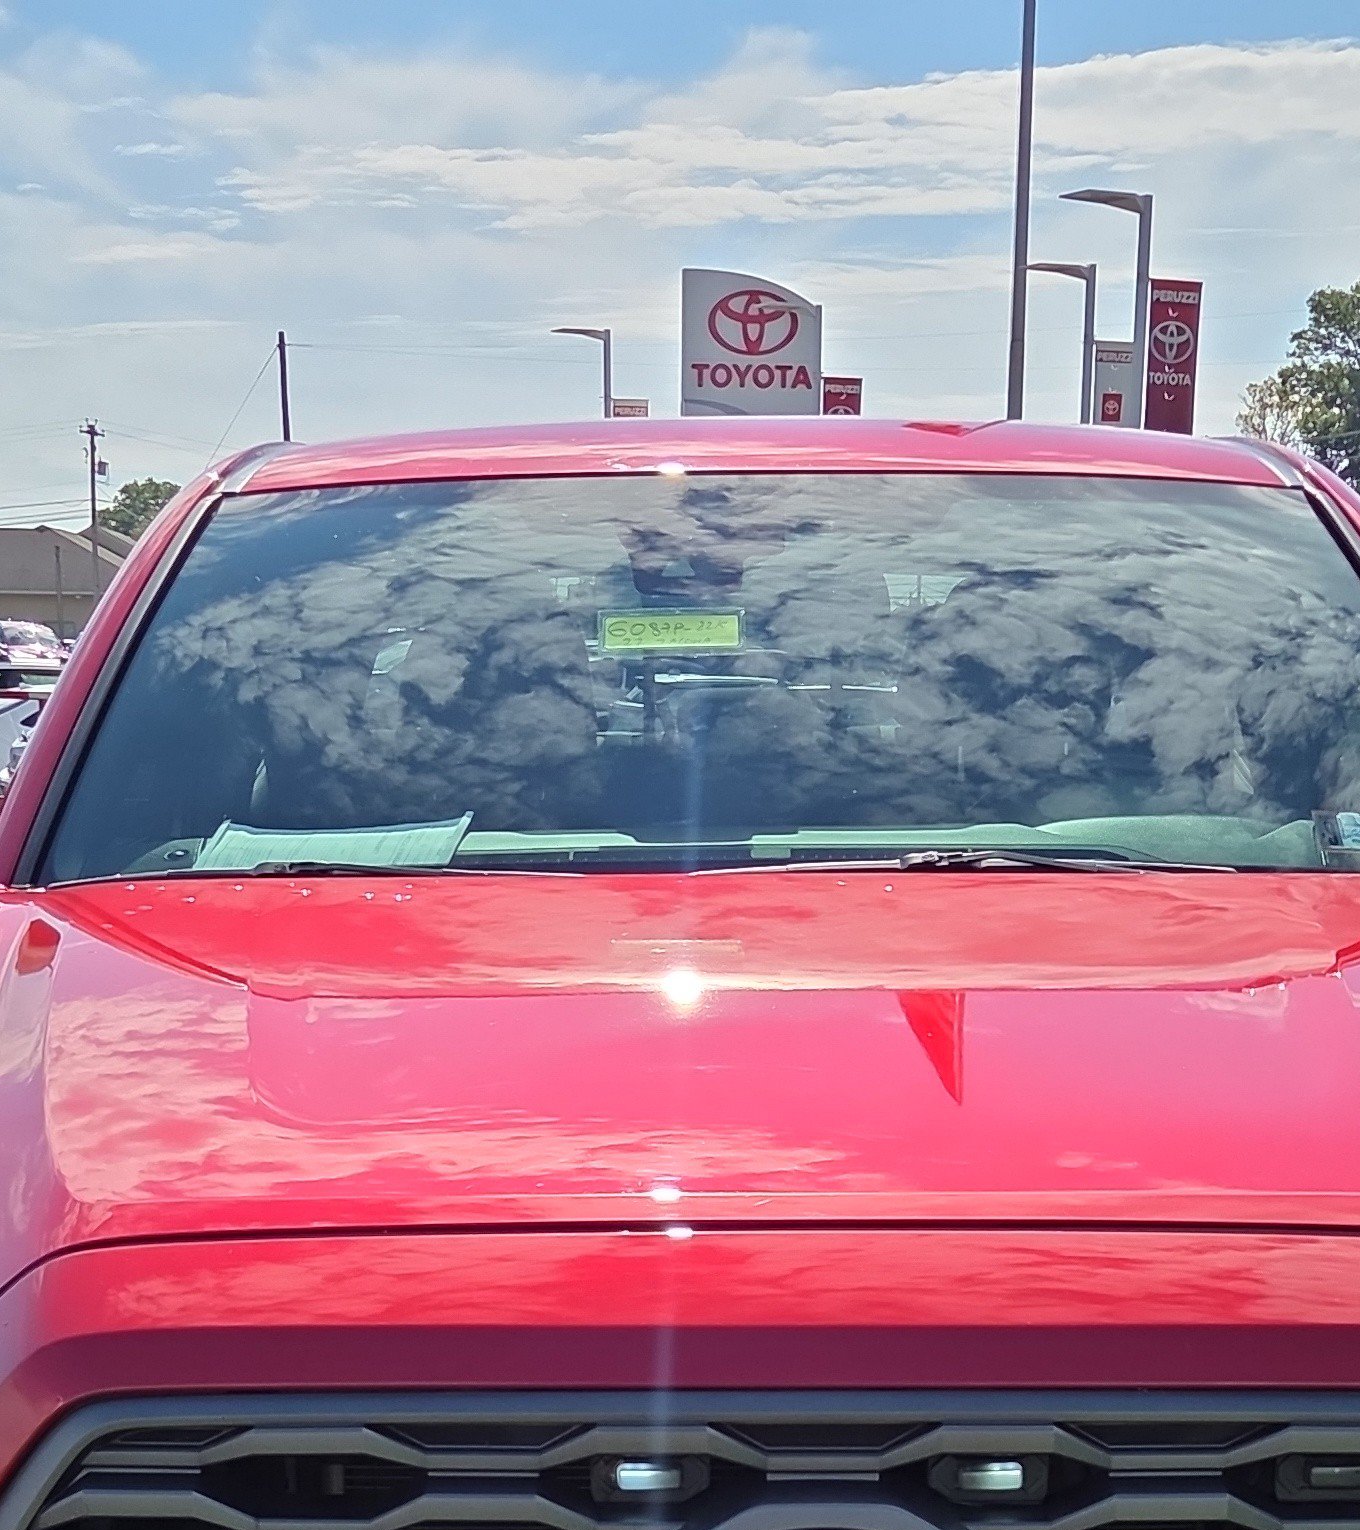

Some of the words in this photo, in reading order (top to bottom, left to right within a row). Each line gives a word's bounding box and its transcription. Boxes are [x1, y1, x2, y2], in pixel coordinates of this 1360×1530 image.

[1153, 289, 1200, 304] PERUZZI
[690, 363, 813, 390] TOYOTA
[1149, 371, 1191, 386] TOYOTA
